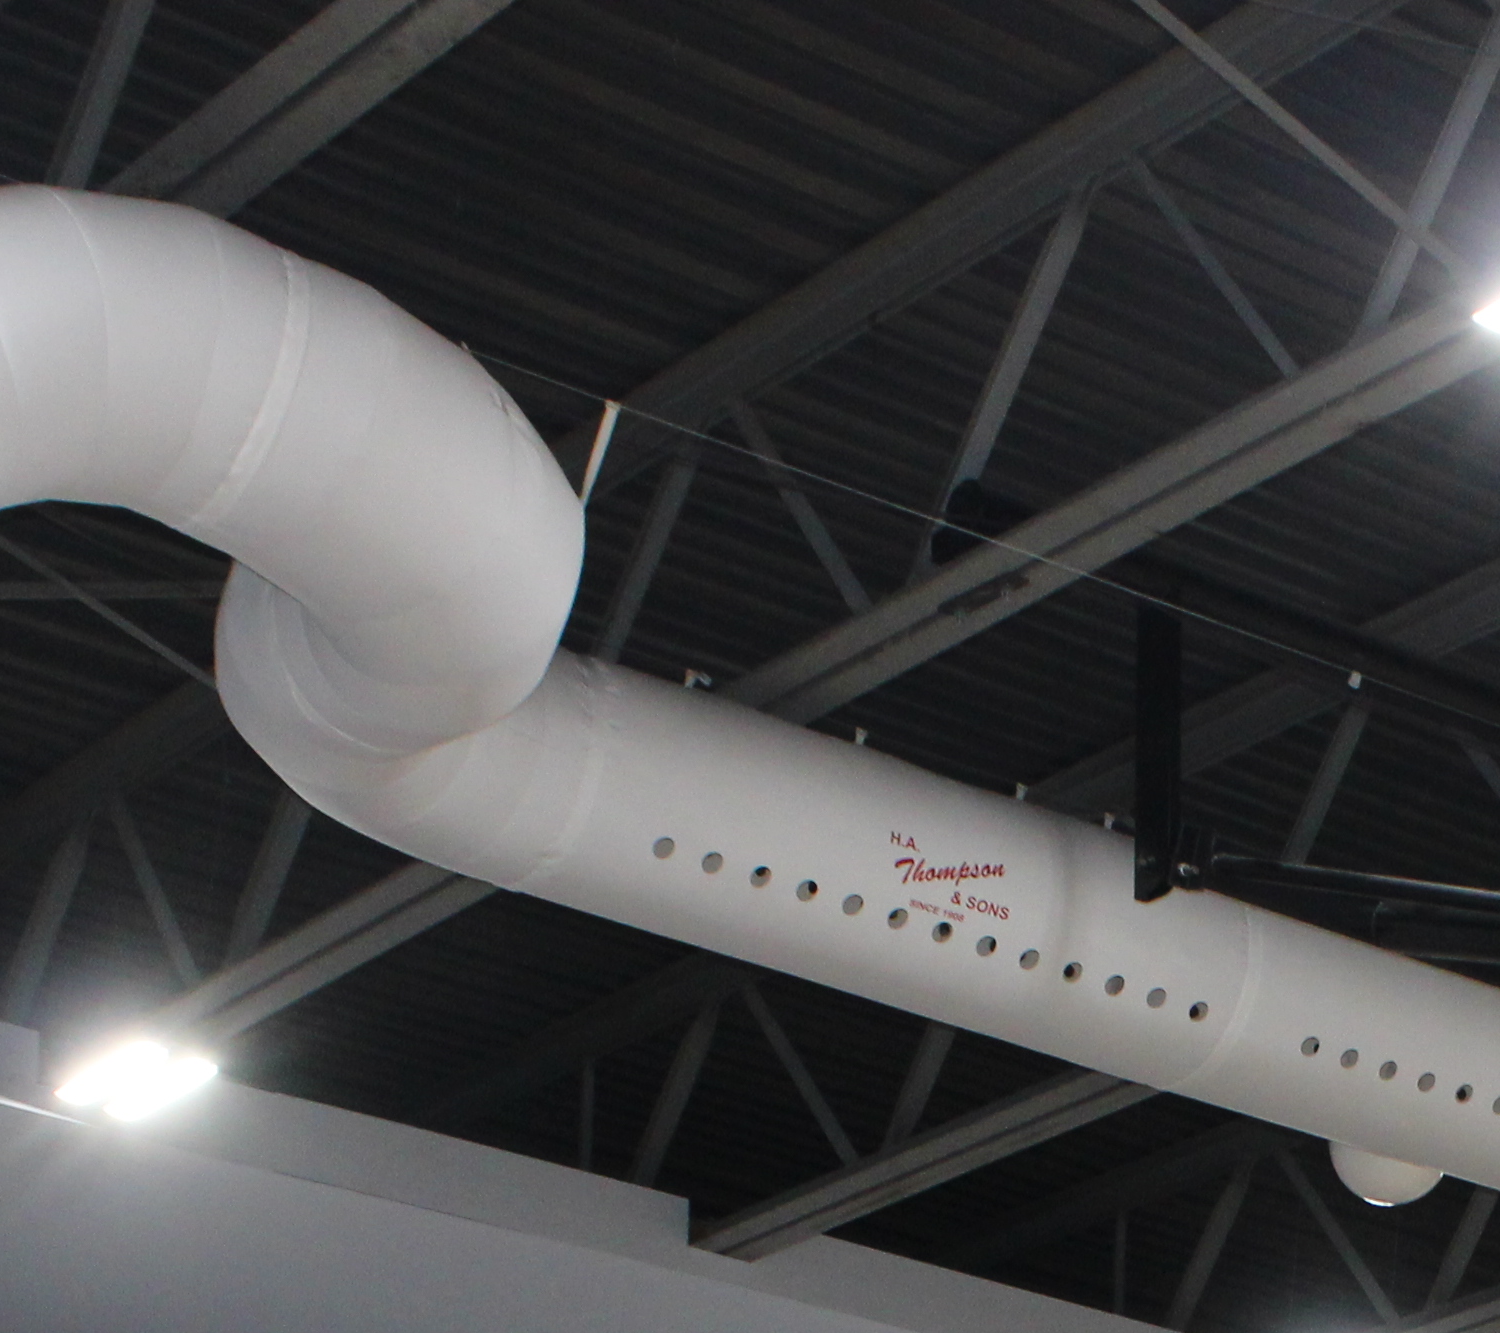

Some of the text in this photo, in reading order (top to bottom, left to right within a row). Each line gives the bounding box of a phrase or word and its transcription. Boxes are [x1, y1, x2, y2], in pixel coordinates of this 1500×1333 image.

[890, 831, 921, 852] H.A.
[894, 857, 1007, 886] Thompson
[908, 899, 939, 917] SINCE
[950, 891, 1010, 920] & SONS
